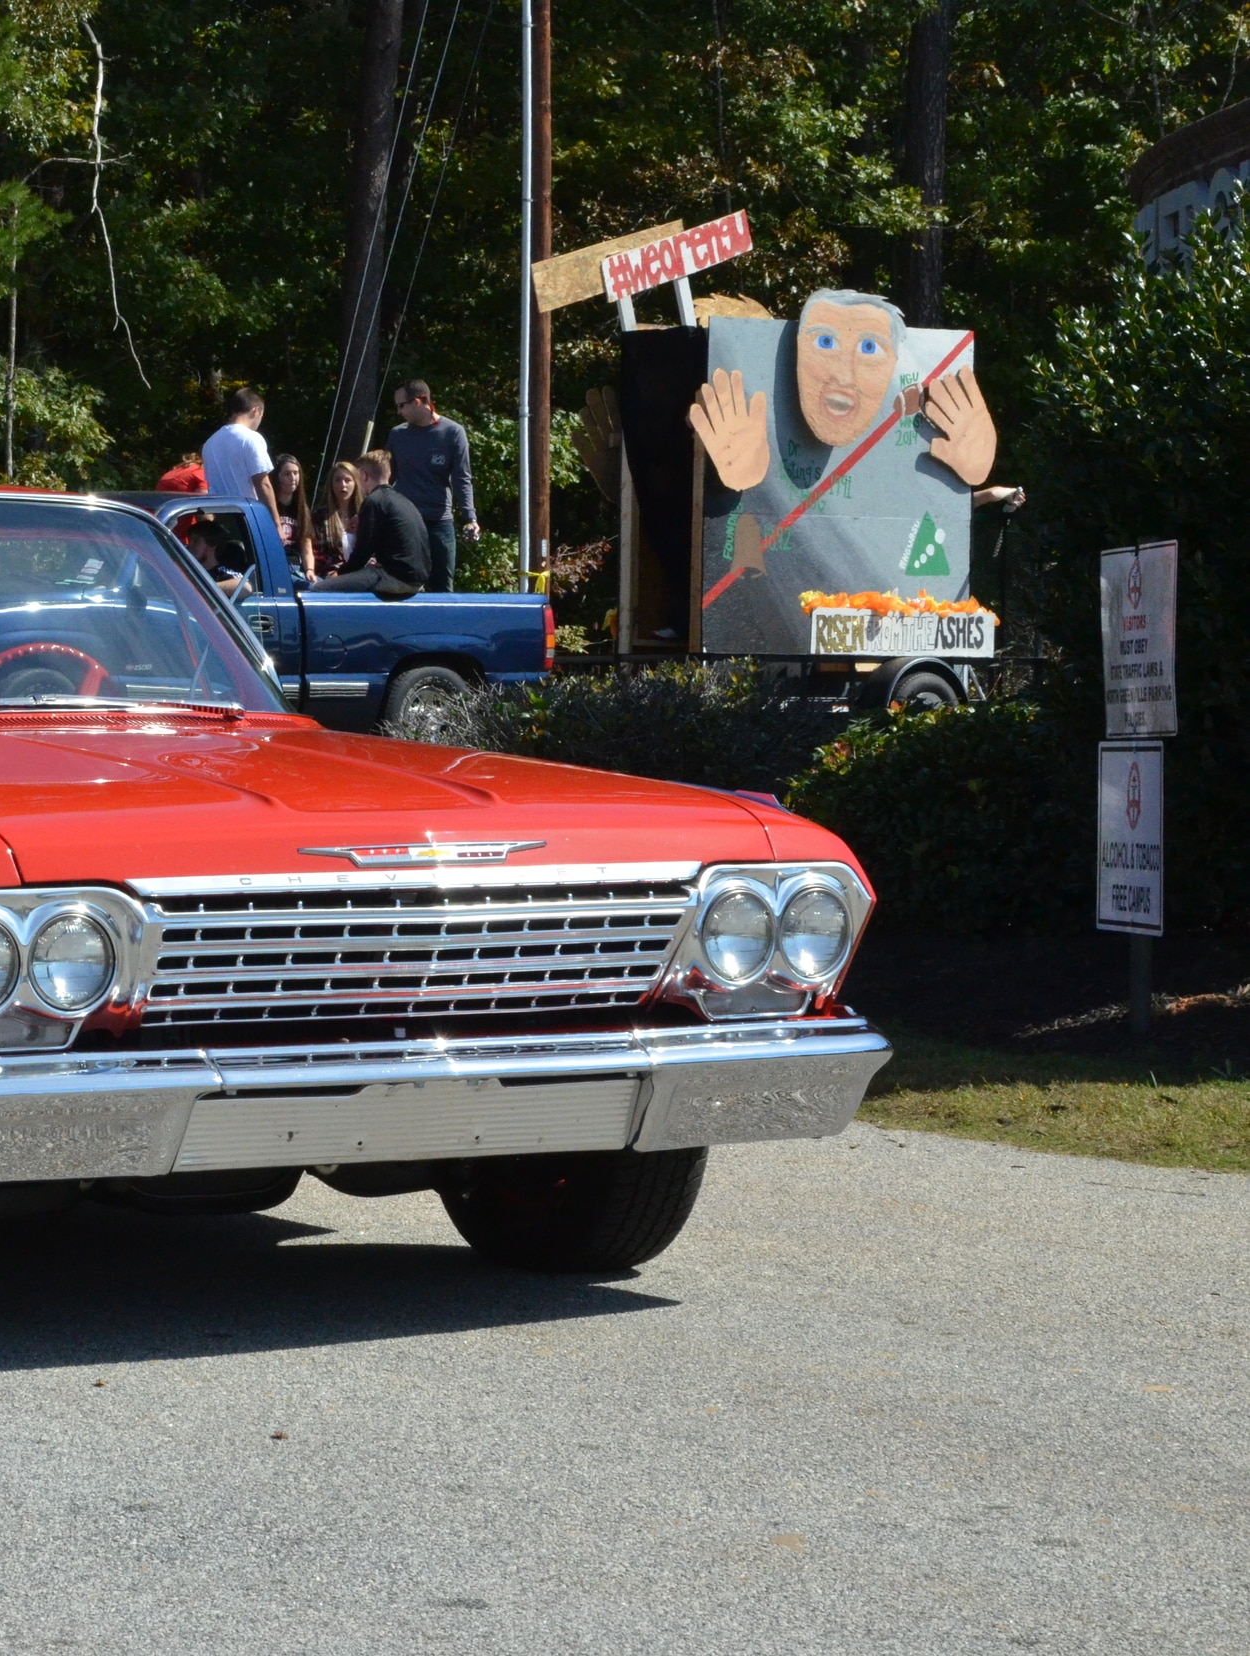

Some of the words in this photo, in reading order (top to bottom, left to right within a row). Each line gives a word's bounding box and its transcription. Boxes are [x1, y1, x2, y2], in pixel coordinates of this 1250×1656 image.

[899, 372, 919, 387] NGU
[895, 430, 918, 447] 2014
[815, 613, 864, 654] RISEN
[864, 614, 903, 653] FROM
[902, 615, 936, 652] THE
[935, 616, 984, 650] ASHES
[1119, 640, 1134, 656] MUST
[1134, 638, 1148, 656] OBEY
[1122, 662, 1142, 680] TRAFFIC
[1143, 661, 1158, 679] LAWS
[1148, 686, 1172, 702] PARKING
[1102, 841, 1129, 870] ALCOHOL
[1135, 843, 1160, 872] TOBACCO
[1111, 884, 1128, 912] FREE
[1128, 885, 1151, 914] CAMPUS
